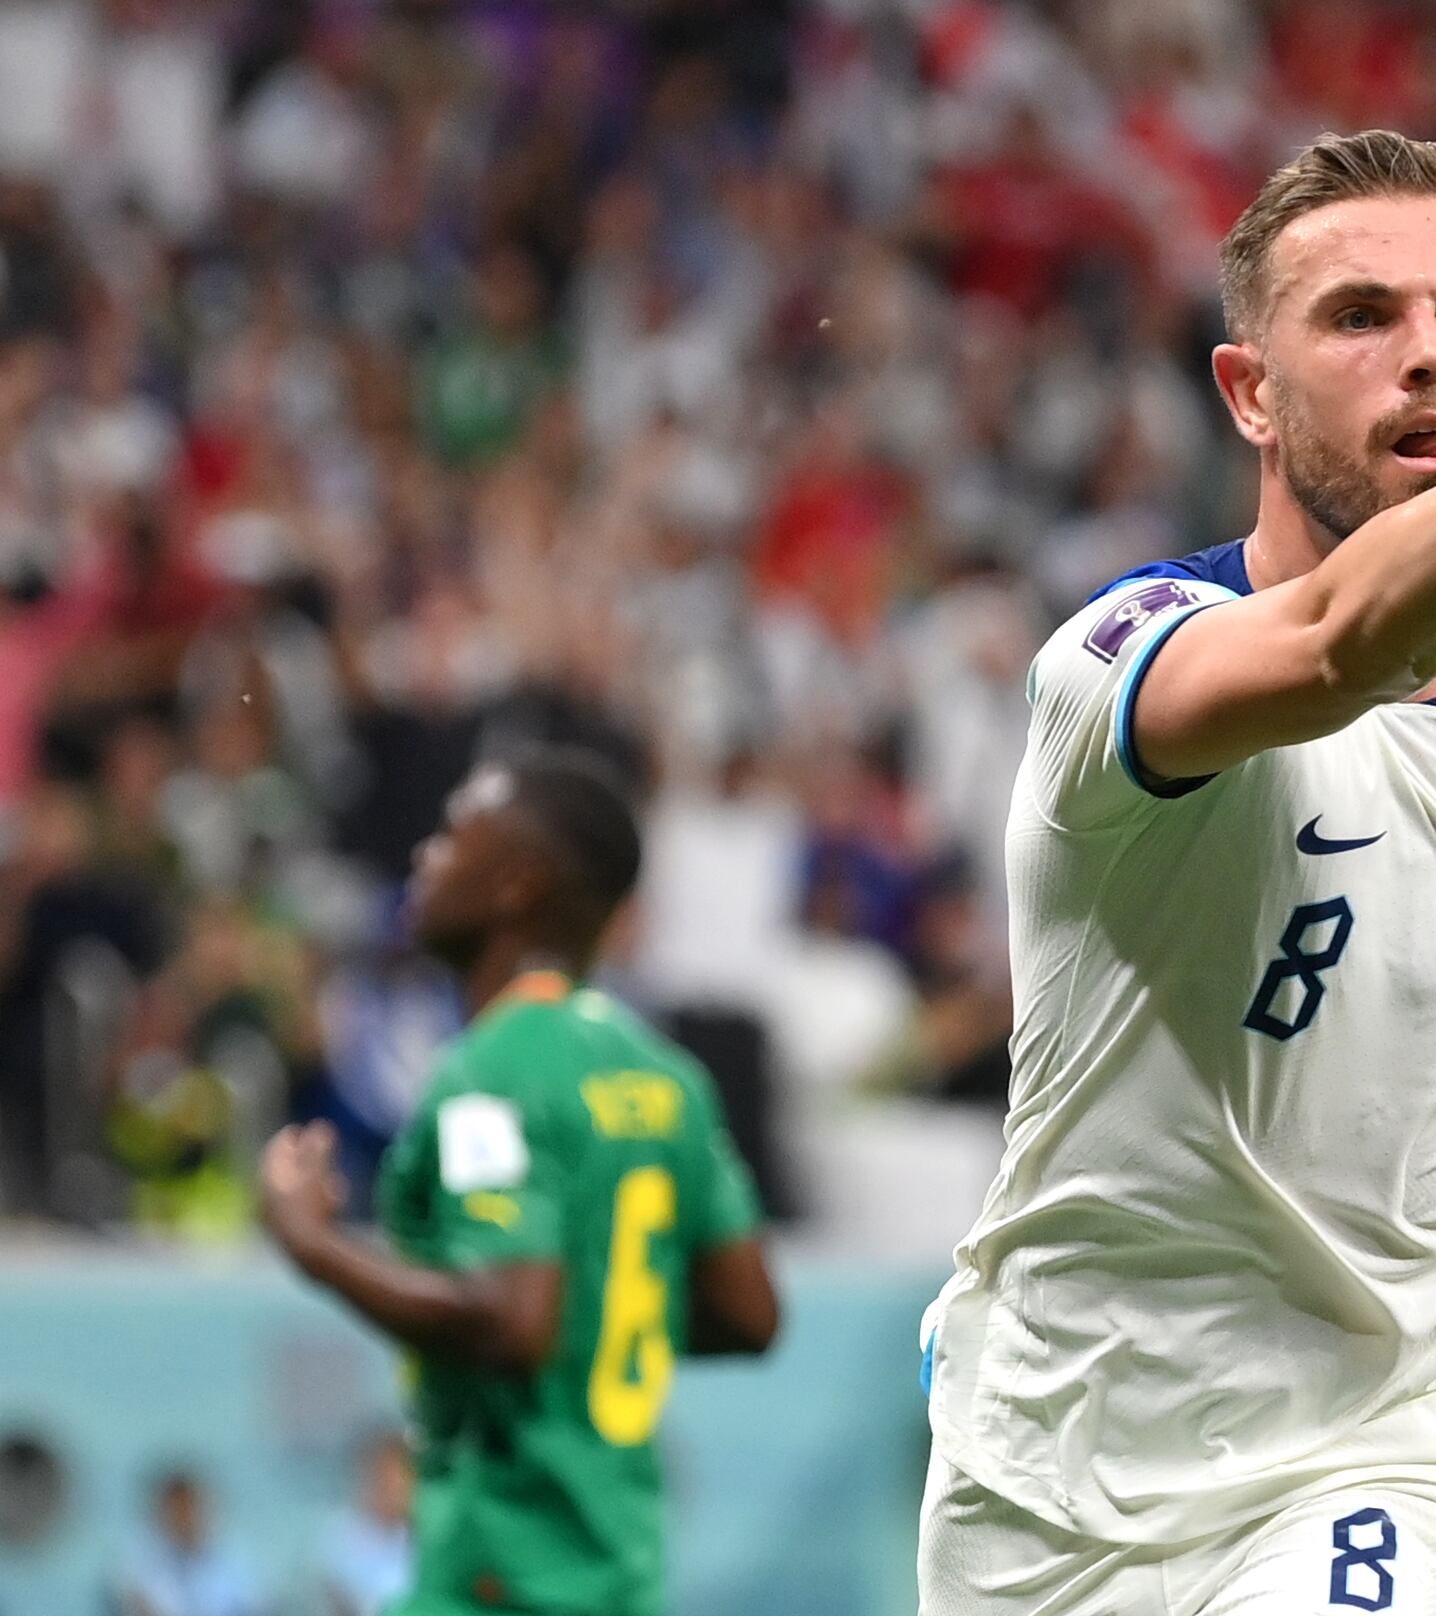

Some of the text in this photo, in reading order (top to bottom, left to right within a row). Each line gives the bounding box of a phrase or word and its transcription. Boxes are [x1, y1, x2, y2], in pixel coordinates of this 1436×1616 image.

[1243, 896, 1354, 1041] 8
[586, 1164, 678, 1447] 6
[1329, 1507, 1397, 1612] 8
